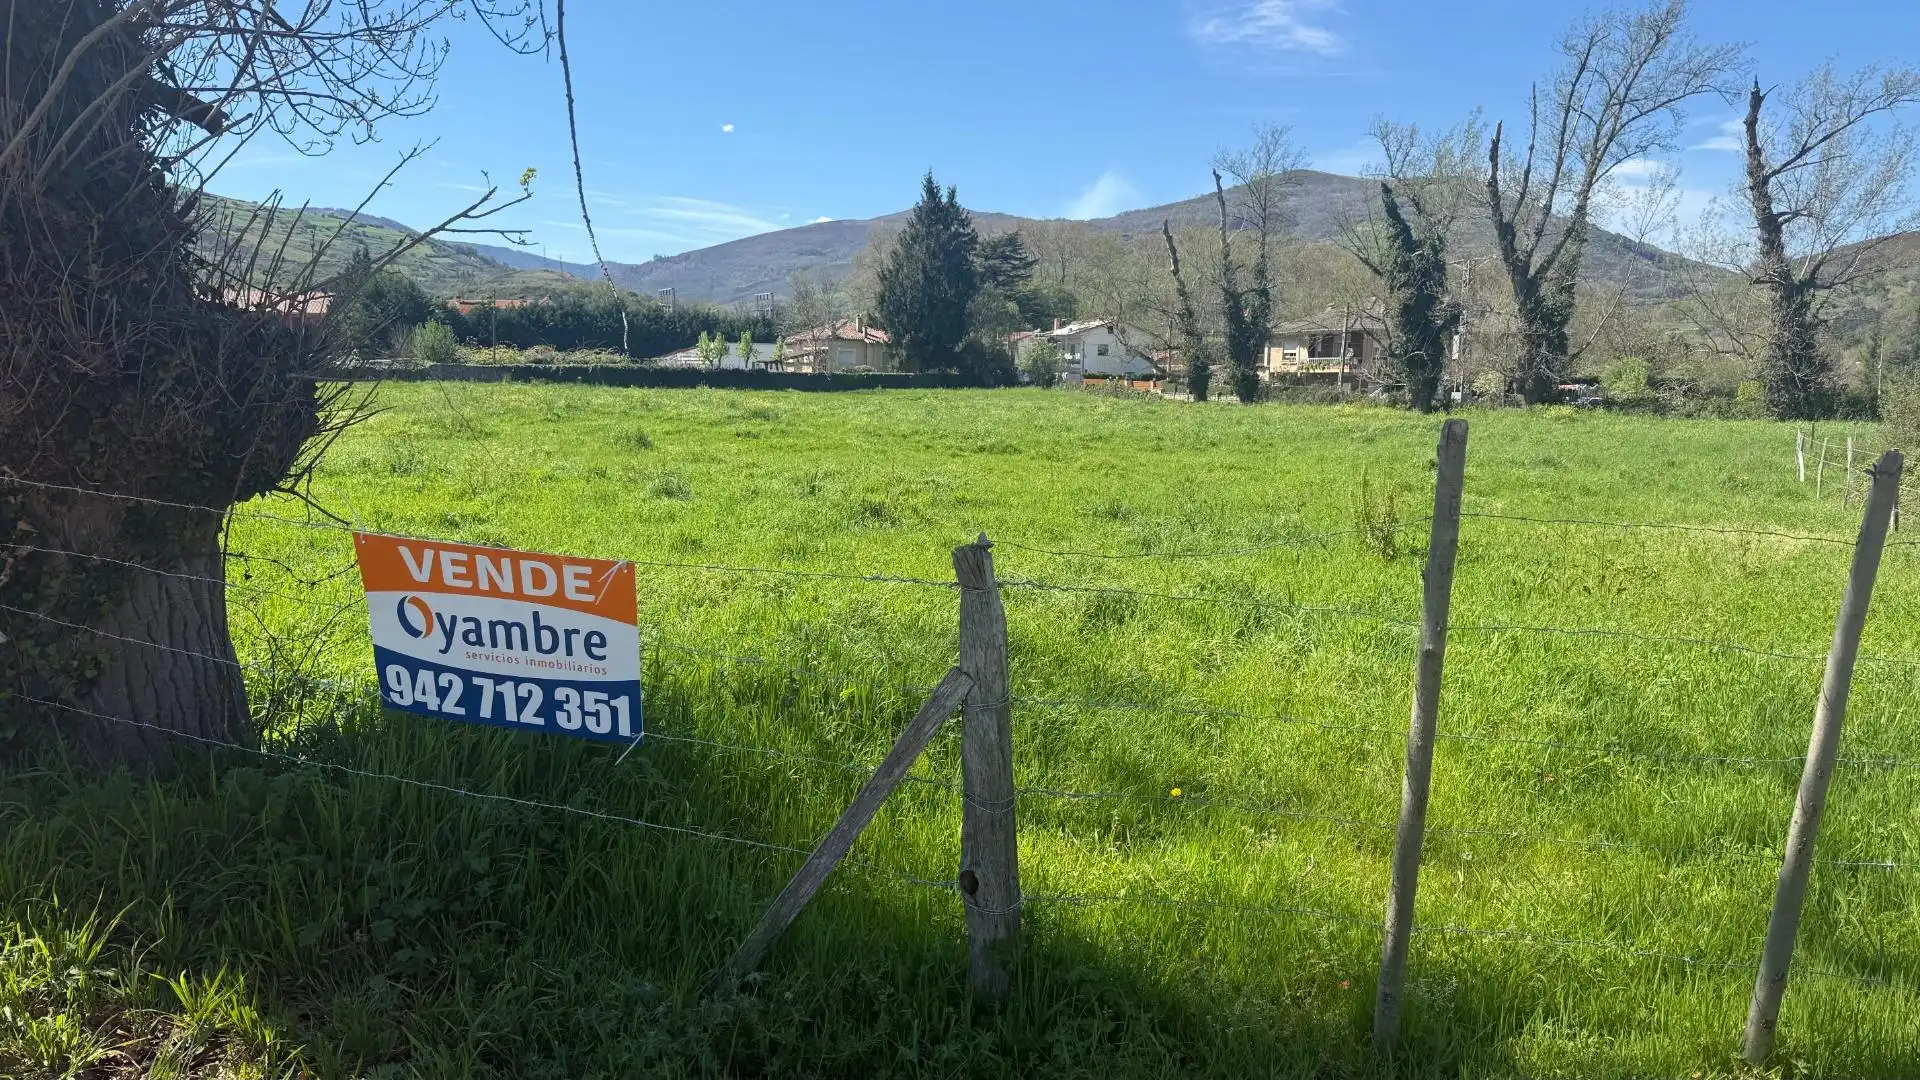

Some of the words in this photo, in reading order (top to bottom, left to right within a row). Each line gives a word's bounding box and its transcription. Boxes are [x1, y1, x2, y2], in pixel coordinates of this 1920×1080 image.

[398, 546, 596, 602] VENDE
[397, 595, 607, 661] Oyambre
[465, 651, 520, 665] servicios
[525, 656, 608, 675] inmobiliarios
[385, 664, 465, 715] 942
[472, 677, 545, 726] 712
[555, 687, 632, 737] 351
